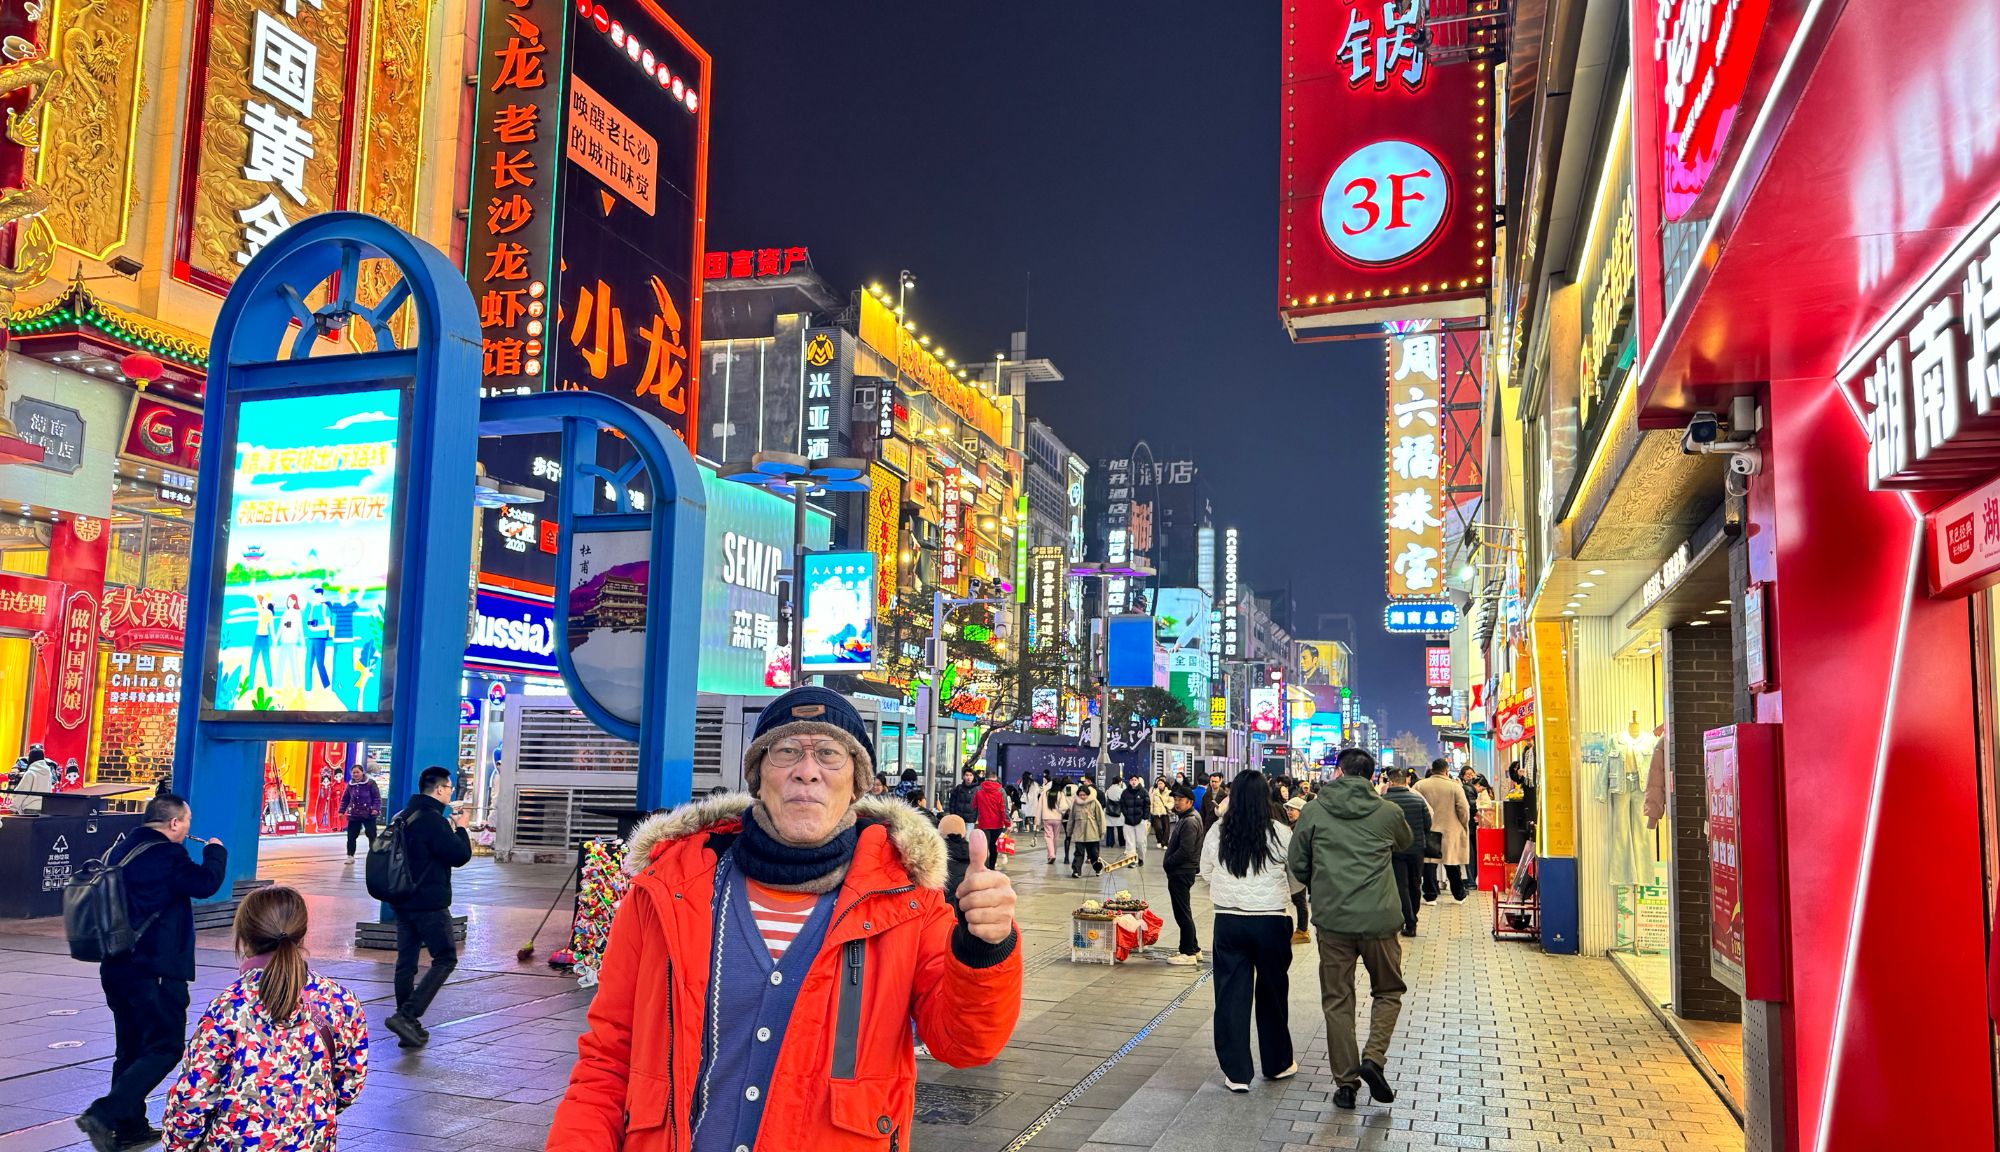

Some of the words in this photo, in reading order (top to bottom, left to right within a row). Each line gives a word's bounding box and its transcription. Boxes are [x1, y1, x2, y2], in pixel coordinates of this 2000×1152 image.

[570, 124, 650, 201] 的城市味觉
[572, 89, 651, 167] 唤醒老长沙
[1342, 168, 1432, 236] 3F
[703, 247, 806, 279] 国富资产
[532, 456, 562, 483] 步行
[805, 371, 832, 497] 米亚酒
[1390, 335, 1442, 591] 周六福珠宝
[63, 608, 91, 712] 做中国新娘
[111, 674, 158, 687] China
[1211, 696, 1226, 727] 湘菜
